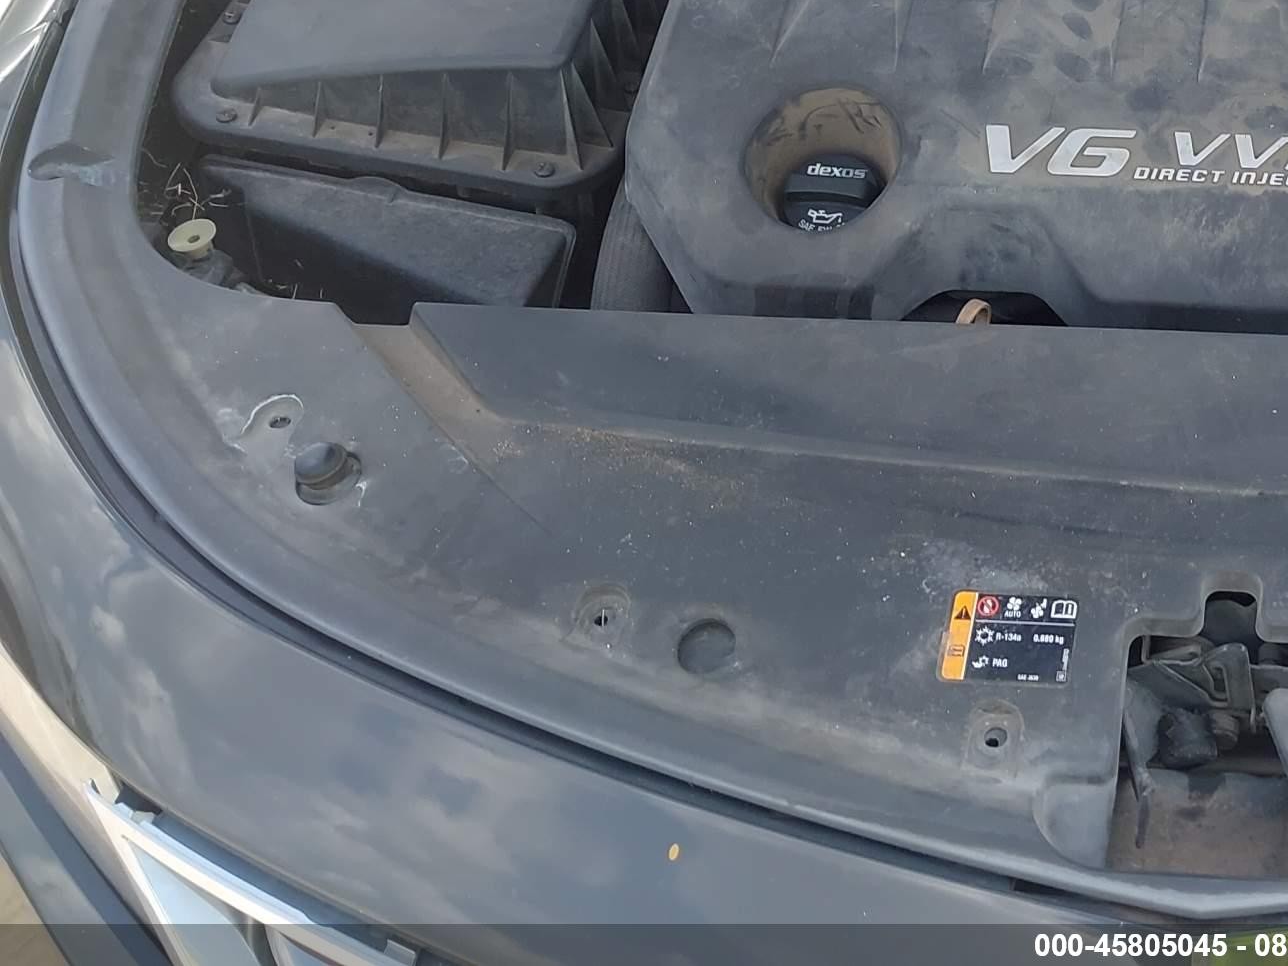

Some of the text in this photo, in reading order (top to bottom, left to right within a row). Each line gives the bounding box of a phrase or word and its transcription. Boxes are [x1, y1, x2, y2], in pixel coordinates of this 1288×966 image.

[985, 124, 1137, 177] V6
[806, 162, 867, 179] dexos
[1133, 166, 1226, 183] DIRECT
[1004, 610, 1022, 618] AUTO
